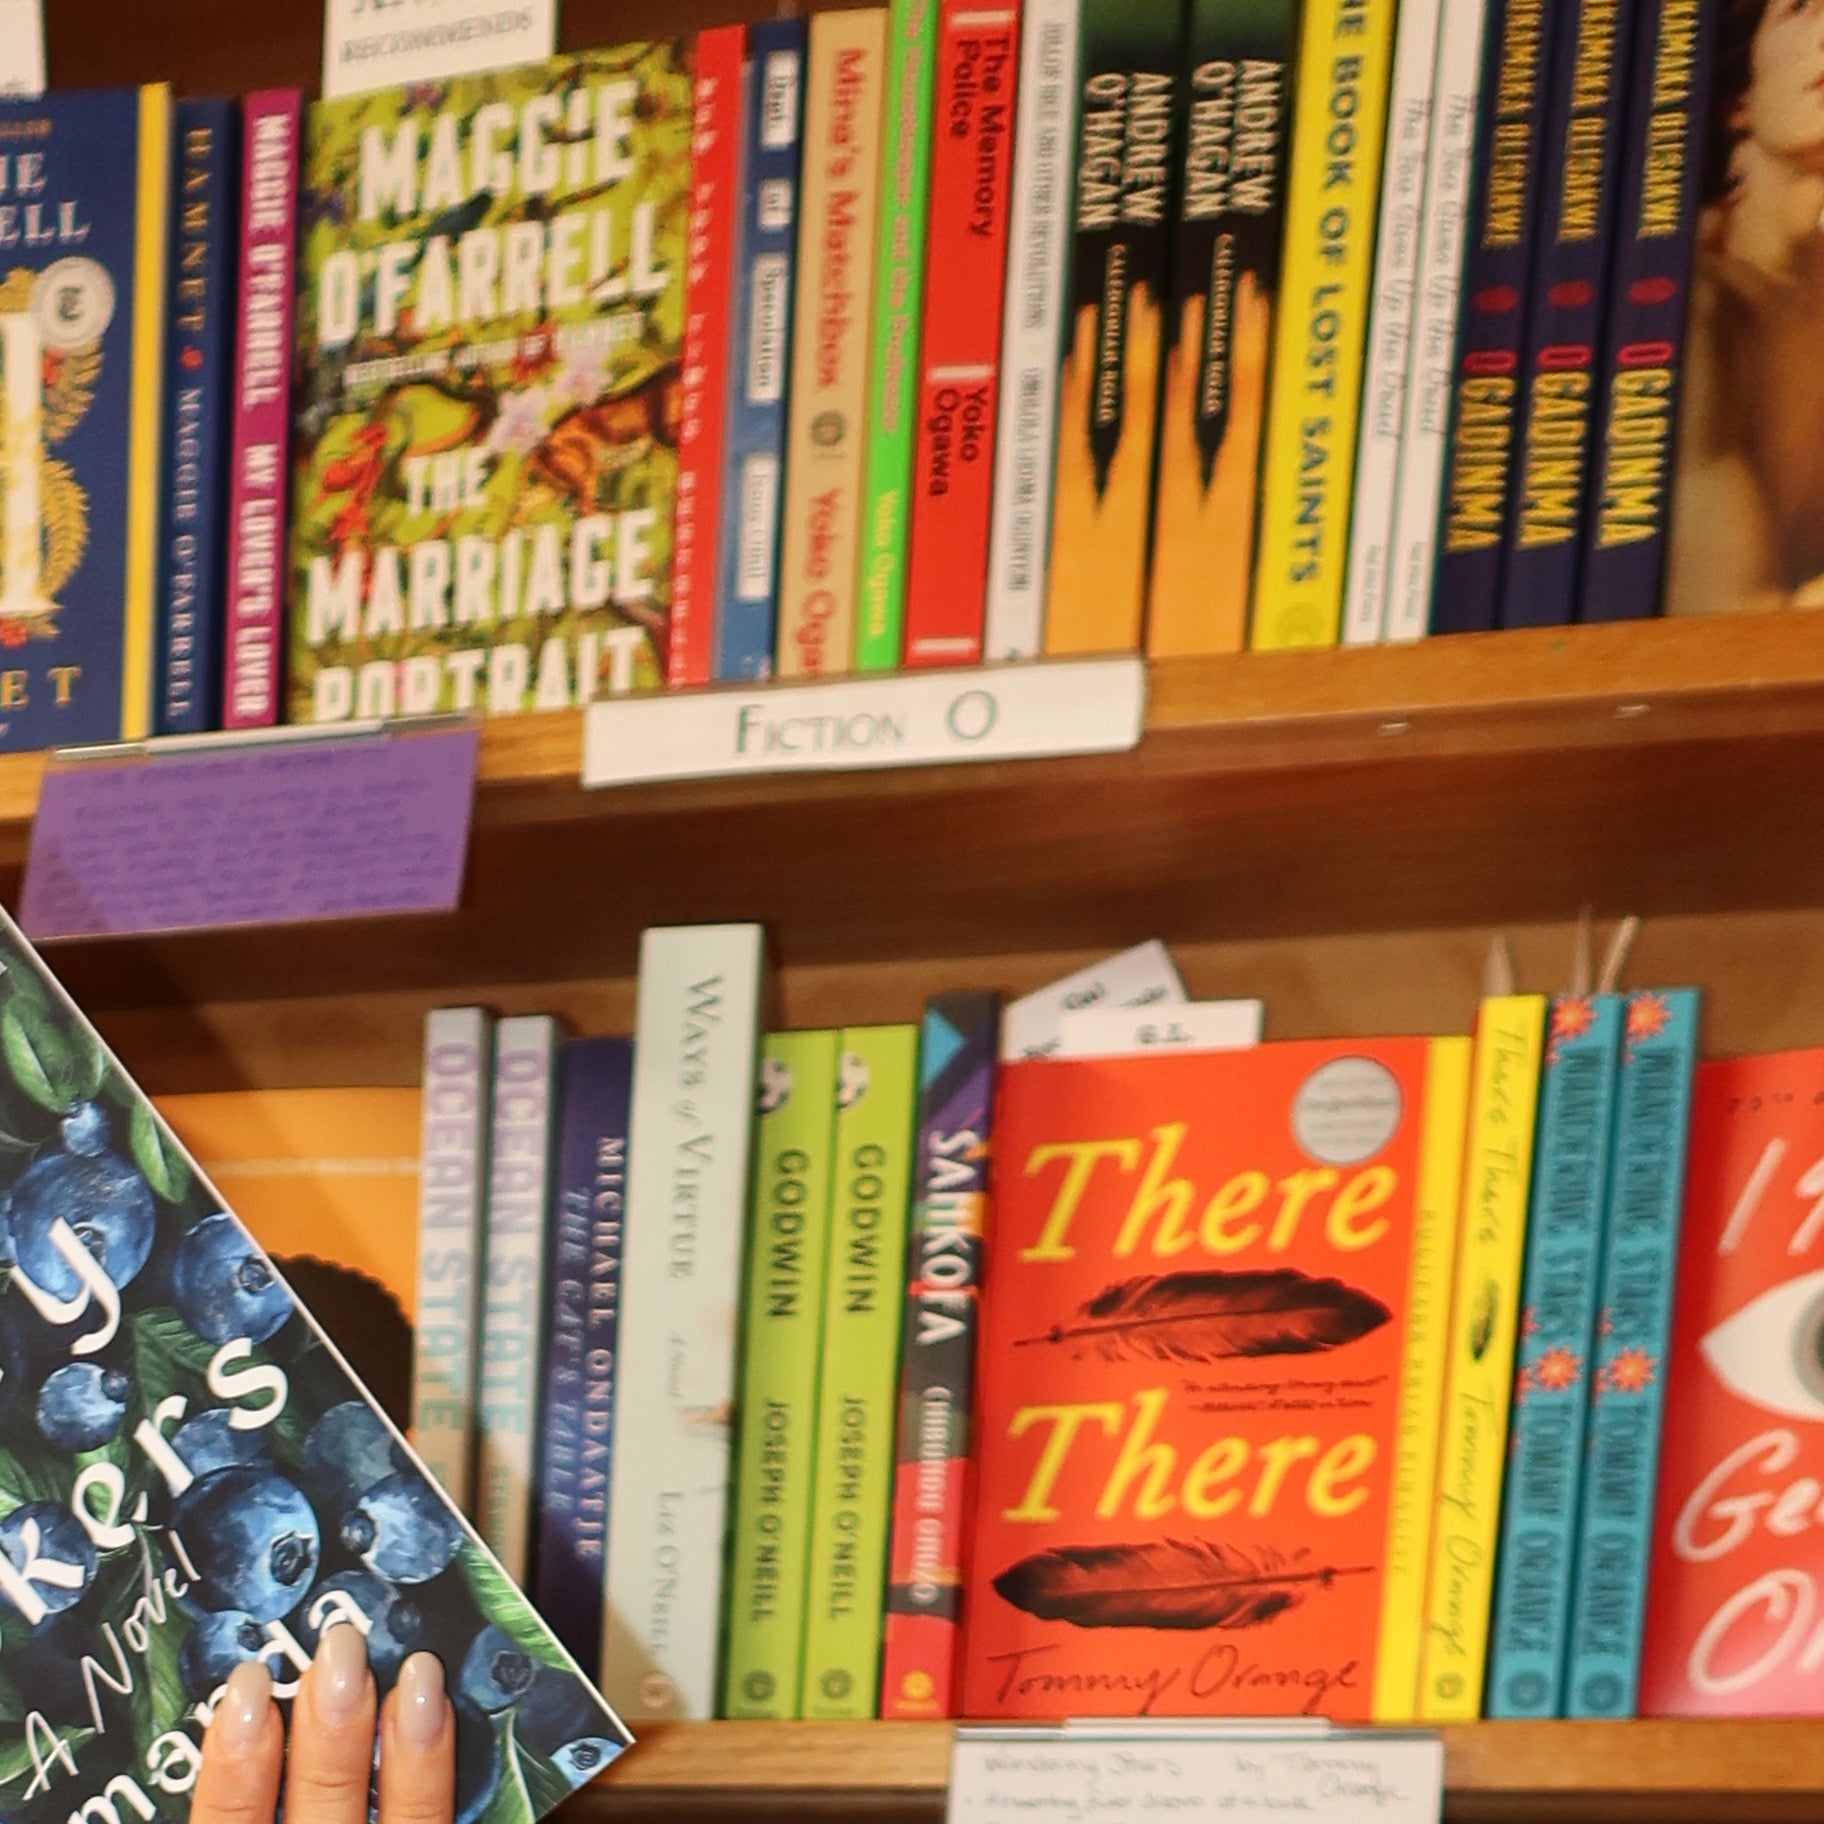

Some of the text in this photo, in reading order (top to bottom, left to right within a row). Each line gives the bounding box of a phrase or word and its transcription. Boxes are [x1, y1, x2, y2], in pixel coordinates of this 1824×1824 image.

[358, 80, 638, 221] MAGGIE
[949, 39, 979, 141] Police
[967, 32, 1012, 238] The Memory
[1074, 73, 1127, 233] O'HAGAN
[1122, 70, 1174, 225] ANDREW
[1180, 60, 1237, 223] O'HAGAN
[1230, 58, 1284, 215] ANDREW
[1319, 54, 1366, 196] BOOK
[177, 127, 214, 332] HAMNET
[241, 114, 292, 408] MAGGIE O'FARRELL
[318, 201, 670, 346] O'FARRELL
[816, 47, 869, 391] Mina's Matchbox
[1317, 205, 1354, 271] OF
[1302, 282, 1344, 402] LOST
[241, 443, 280, 488] MY
[405, 449, 493, 517] THE
[924, 387, 961, 498] Ogawa
[959, 386, 990, 464] Yoko
[1287, 414, 1332, 586] SAINTS
[1443, 349, 1519, 553] OGADINMA
[1515, 345, 1596, 551] OGADINMA
[1595, 340, 1677, 551] OGADINMA
[168, 388, 202, 720] MAGGIE O'FARRELL
[305, 506, 658, 648] MARRIAGE
[233, 626, 274, 717] LOVER
[308, 626, 647, 721] PORTRAIT
[734, 688, 999, 756] FICTION O
[1017, 1121, 1401, 1265] There
[1477, 1024, 1529, 1247] There There
[417, 1041, 481, 1432] OCEAN STATE
[481, 1048, 544, 1438] OCEAN STATE
[764, 1146, 813, 1323] GODWIN
[842, 1142, 888, 1318] GODWIN
[916, 1126, 985, 1348] SANKOFA
[545, 1188, 591, 1518] THE CAT'S TABLE
[573, 1135, 625, 1562] MICHAEL ONDAATJE
[748, 1398, 793, 1623] JOSEPH O'NEILL
[827, 1394, 871, 1621] JOSEPH O'NEILL
[1001, 1389, 1379, 1525] There
[1435, 1383, 1498, 1522] Tommy
[22, 1530, 203, 1801] A Novel
[986, 1641, 1361, 1717] Tommy Orange
